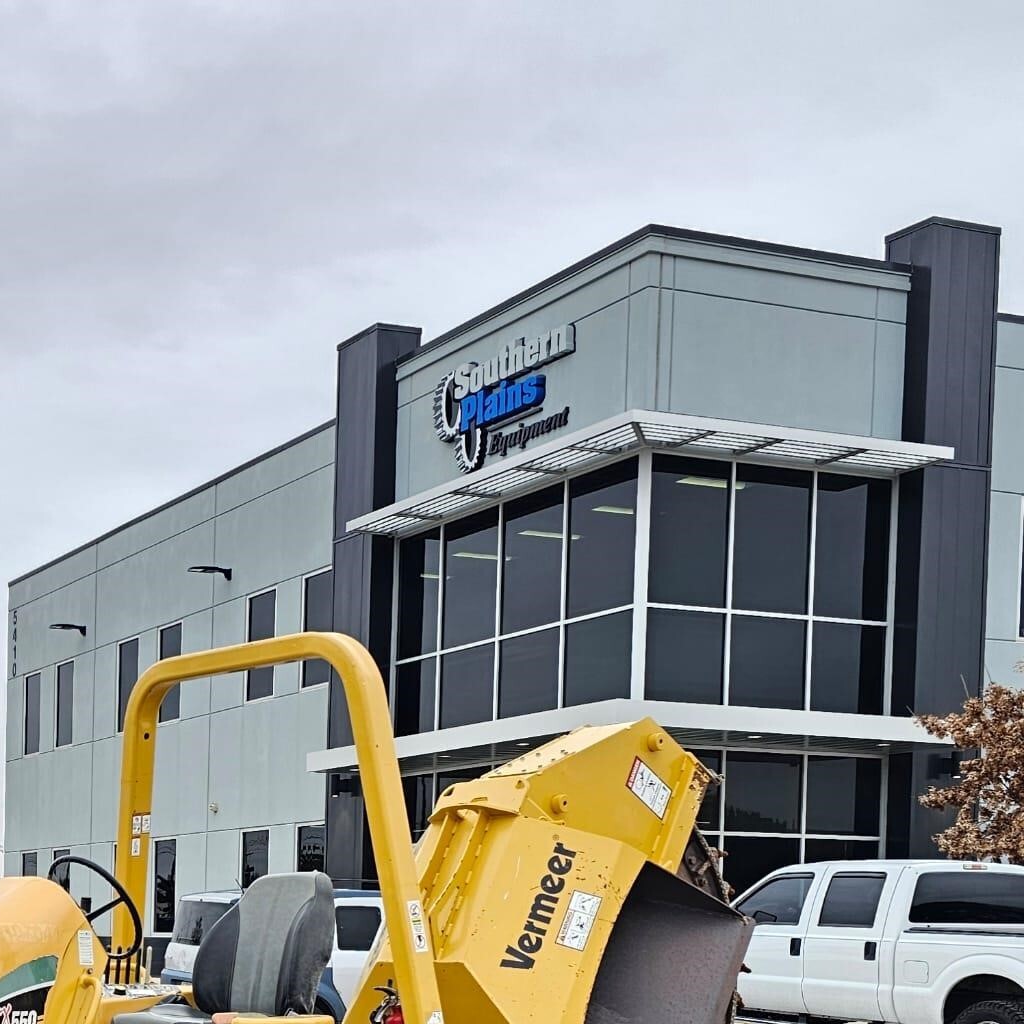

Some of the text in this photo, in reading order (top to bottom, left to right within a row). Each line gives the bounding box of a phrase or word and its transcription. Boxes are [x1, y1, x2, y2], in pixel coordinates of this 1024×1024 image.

[454, 323, 576, 399] Southern
[460, 374, 546, 433] Plains
[487, 406, 570, 456] Equipment
[499, 842, 577, 970] Vermeer
